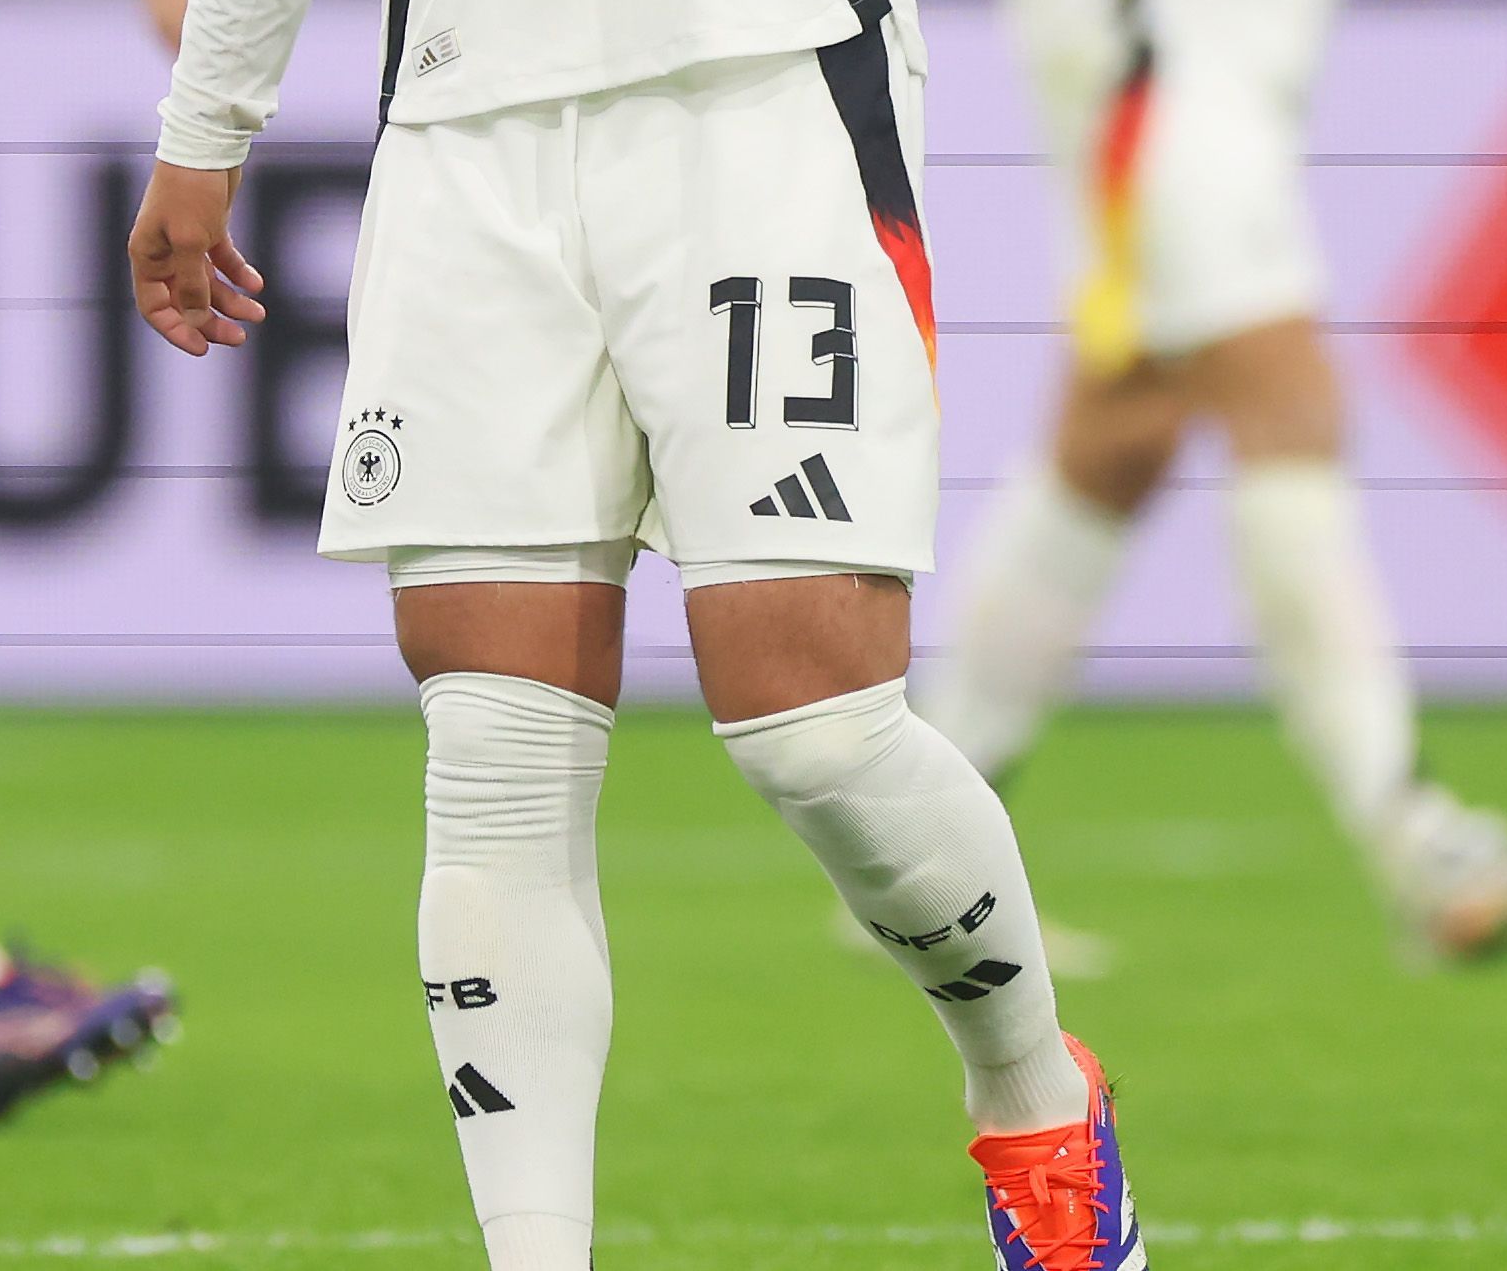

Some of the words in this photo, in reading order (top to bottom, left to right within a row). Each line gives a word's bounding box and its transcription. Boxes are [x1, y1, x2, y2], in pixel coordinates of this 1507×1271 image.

[710, 276, 859, 431] 13
[869, 891, 996, 951] DFB
[422, 977, 498, 1012] FB
